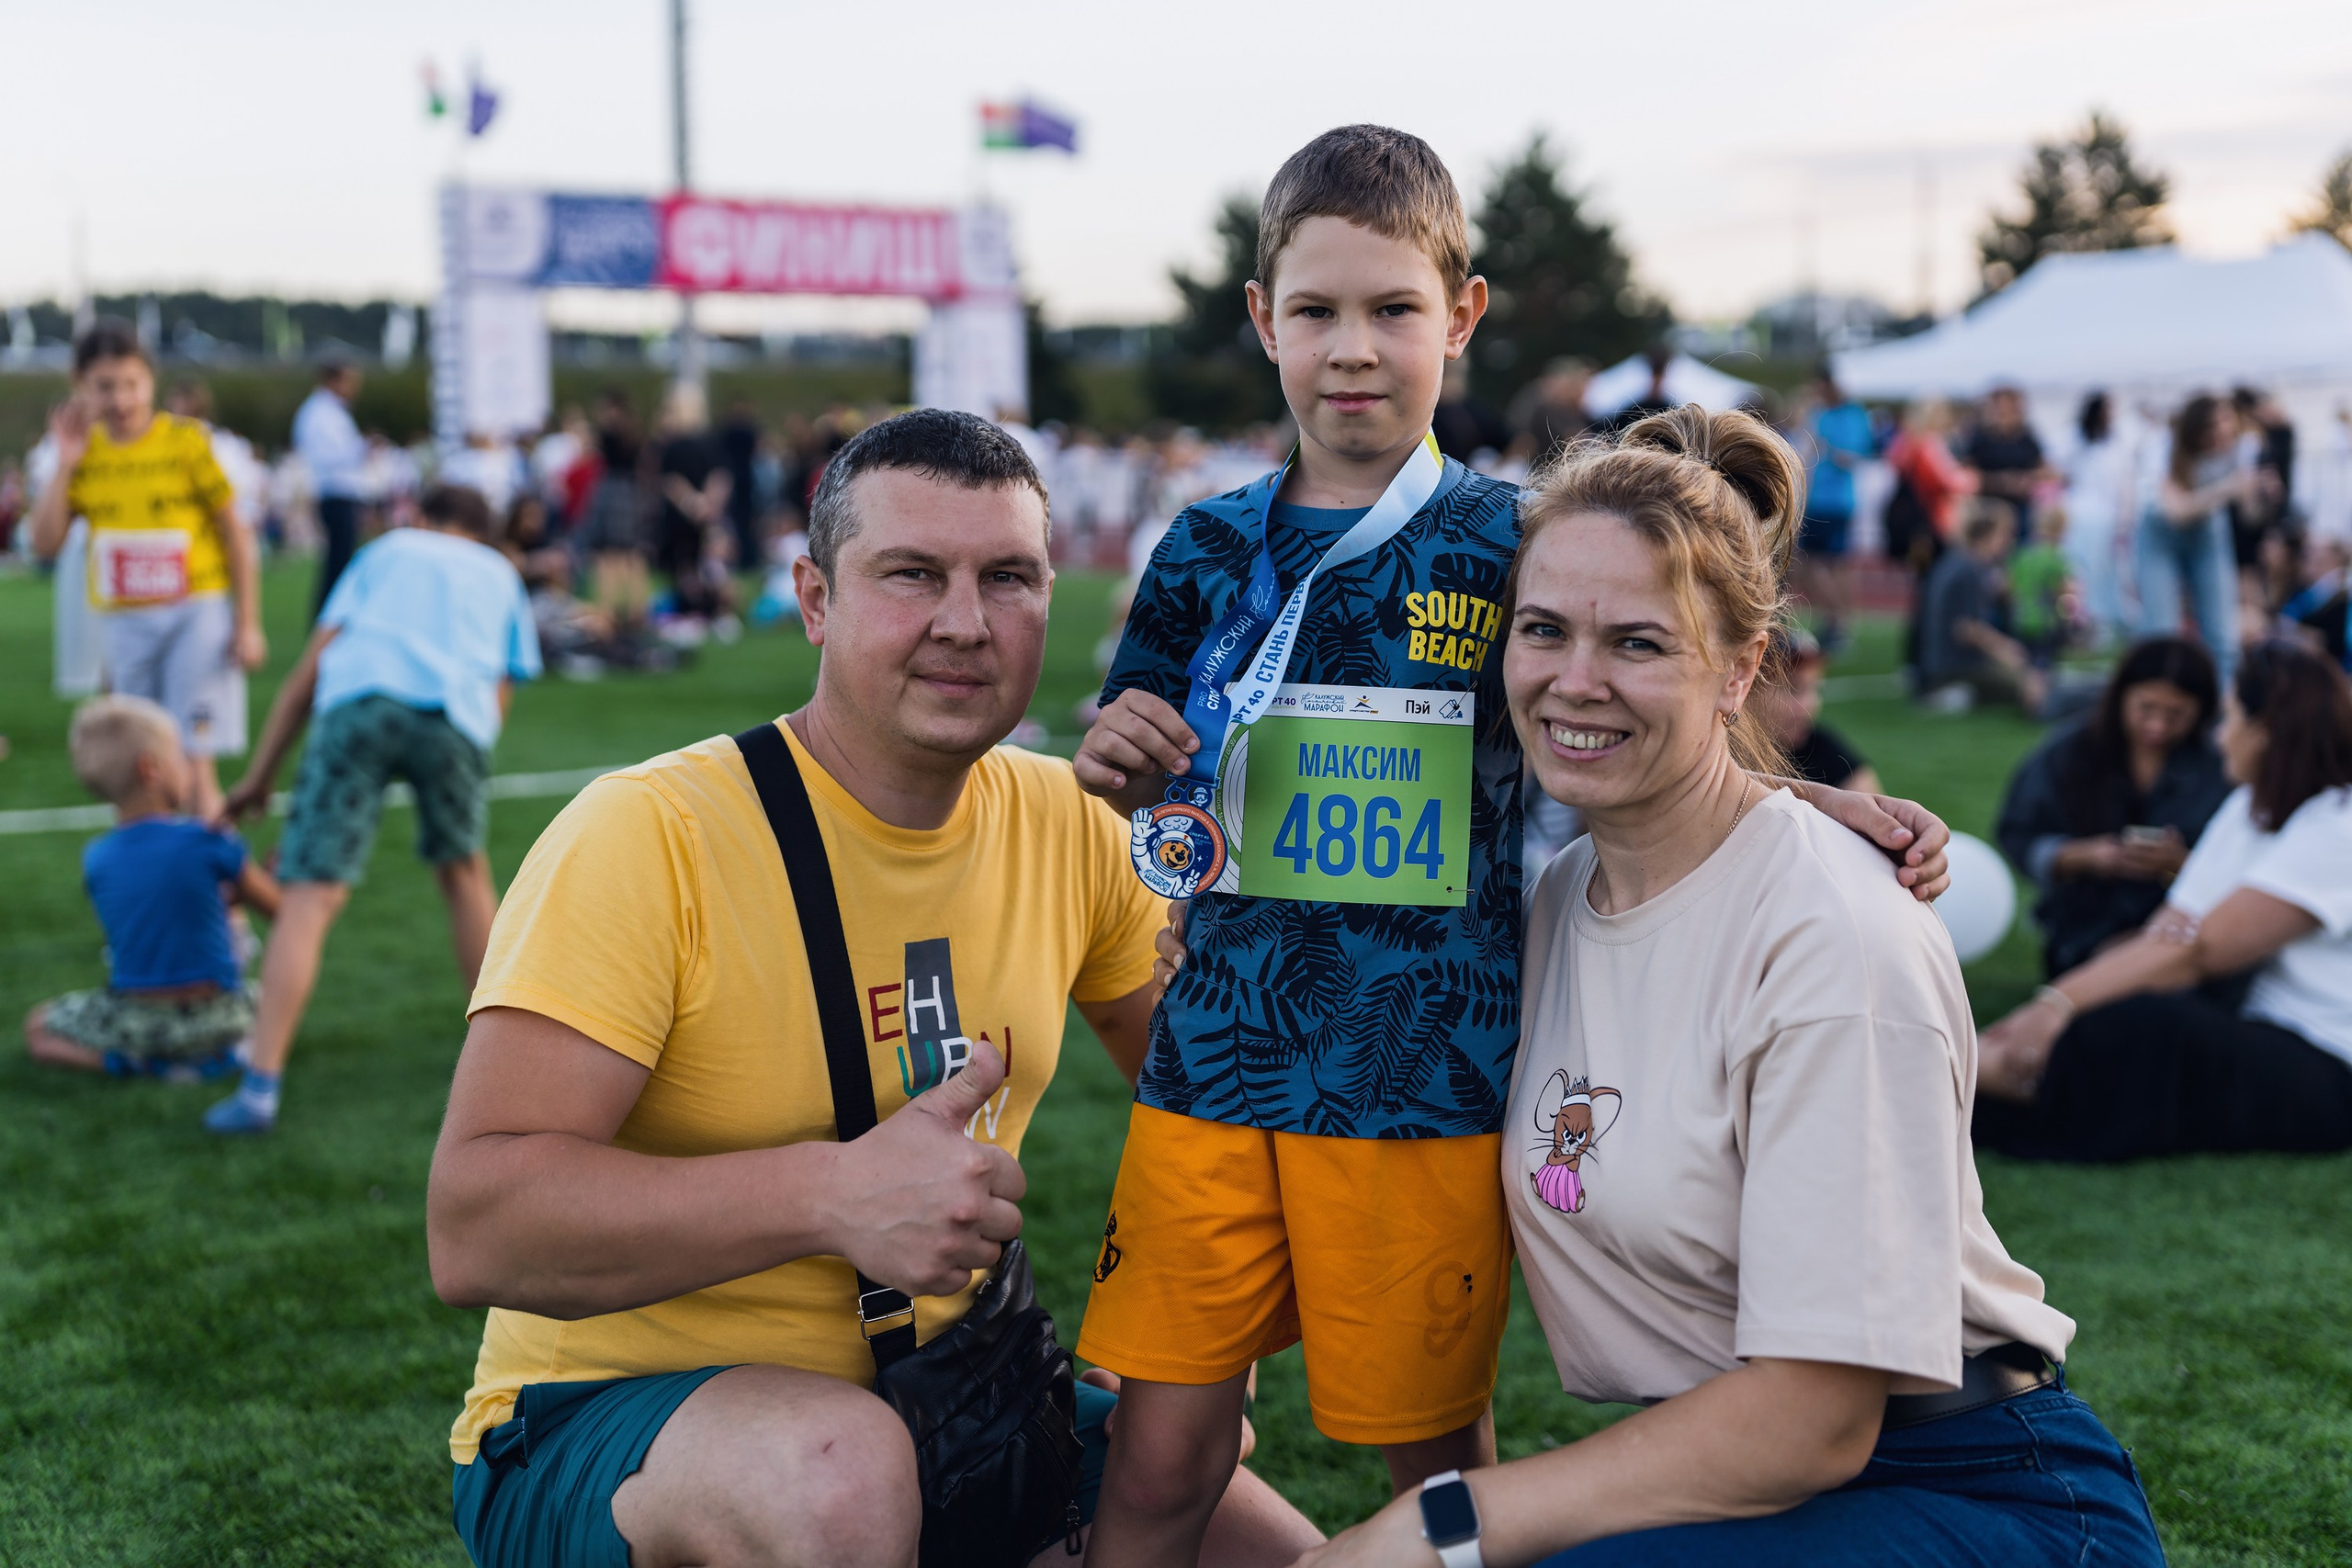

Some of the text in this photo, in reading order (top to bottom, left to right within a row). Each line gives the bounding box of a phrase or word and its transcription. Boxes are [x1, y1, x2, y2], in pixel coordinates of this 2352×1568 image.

[1255, 629, 1289, 683] СТАНЬ
[1281, 576, 1308, 626] ПЕРВ
[1406, 591, 1503, 642] SOUTH
[1408, 629, 1488, 672] BEACH
[1197, 691, 1208, 707] PRO
[1283, 697, 1296, 705] 40
[1304, 703, 1344, 713] МАРАФОН
[1406, 699, 1430, 715] Пэй
[1298, 742, 1421, 782] МАКСИМ
[1272, 793, 1444, 880] 4864
